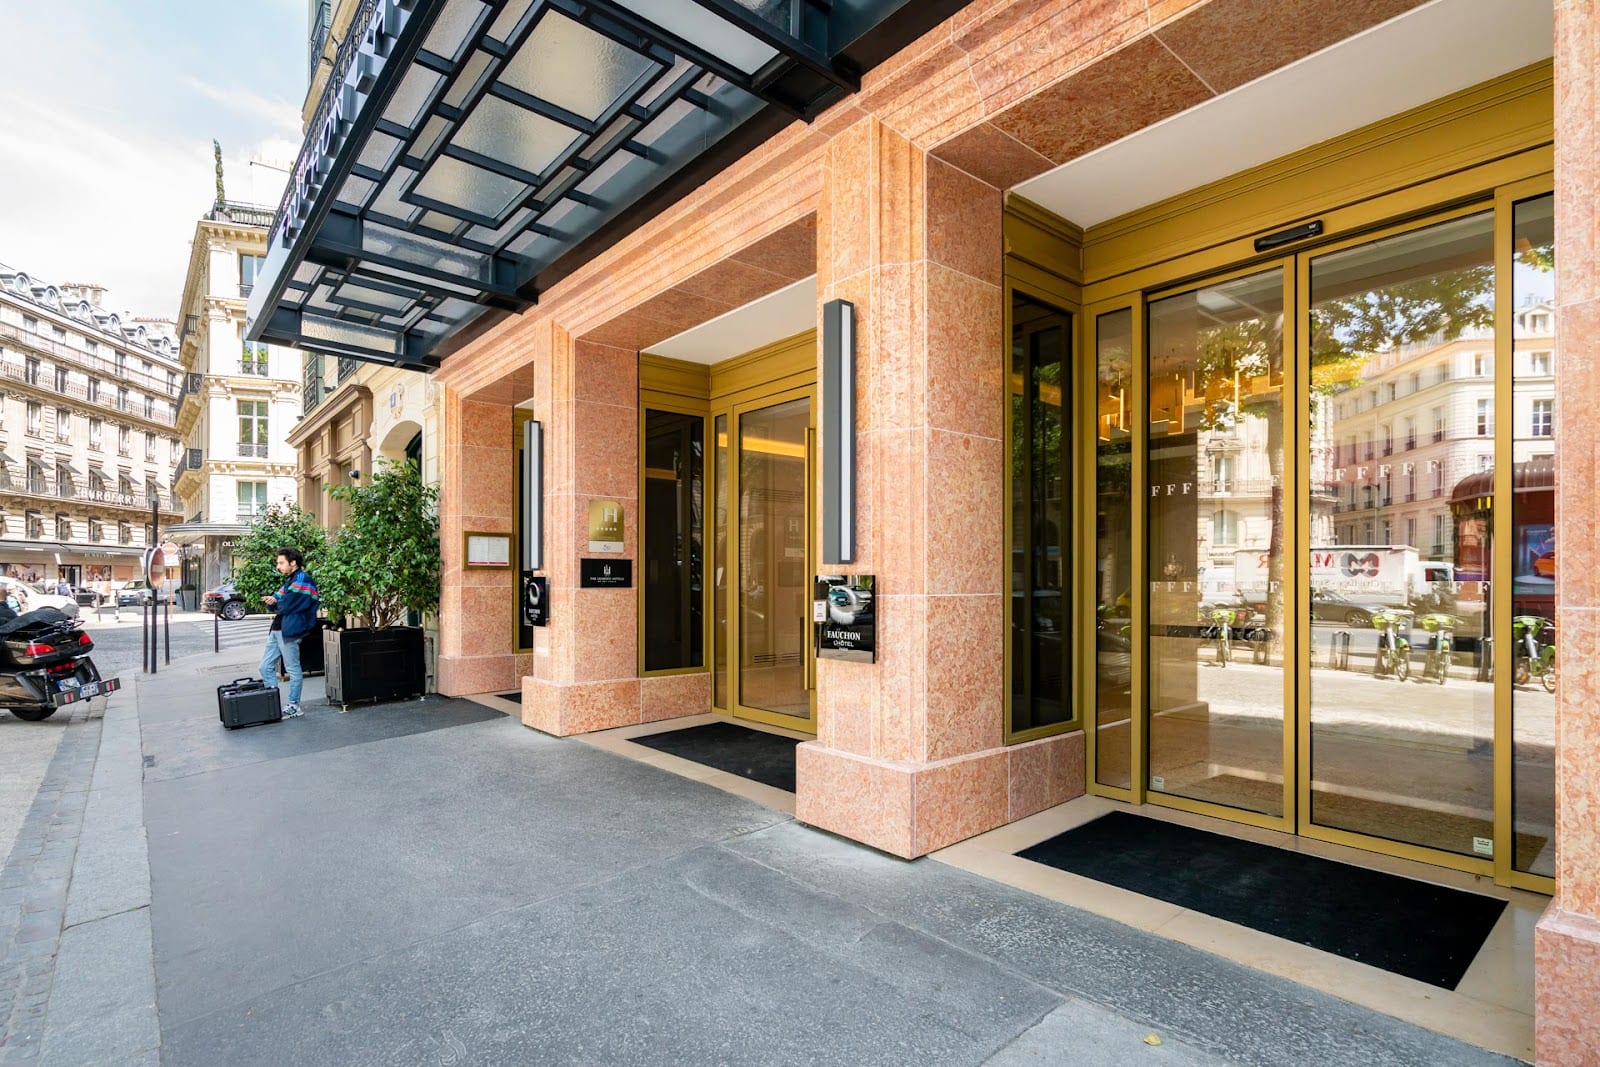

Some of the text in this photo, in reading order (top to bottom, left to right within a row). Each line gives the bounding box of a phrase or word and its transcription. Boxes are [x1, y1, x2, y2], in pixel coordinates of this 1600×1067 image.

[1335, 468, 1347, 481] F
[1357, 466, 1369, 480] F
[1379, 464, 1391, 478] F
[1402, 462, 1415, 476] F
[1151, 485, 1161, 497] F
[1166, 484, 1176, 496] F
[1182, 482, 1192, 495] F
[603, 508, 618, 523] H
[1167, 581, 1176, 593] F
[1183, 581, 1193, 593] F
[827, 630, 861, 641] FAUCHON
